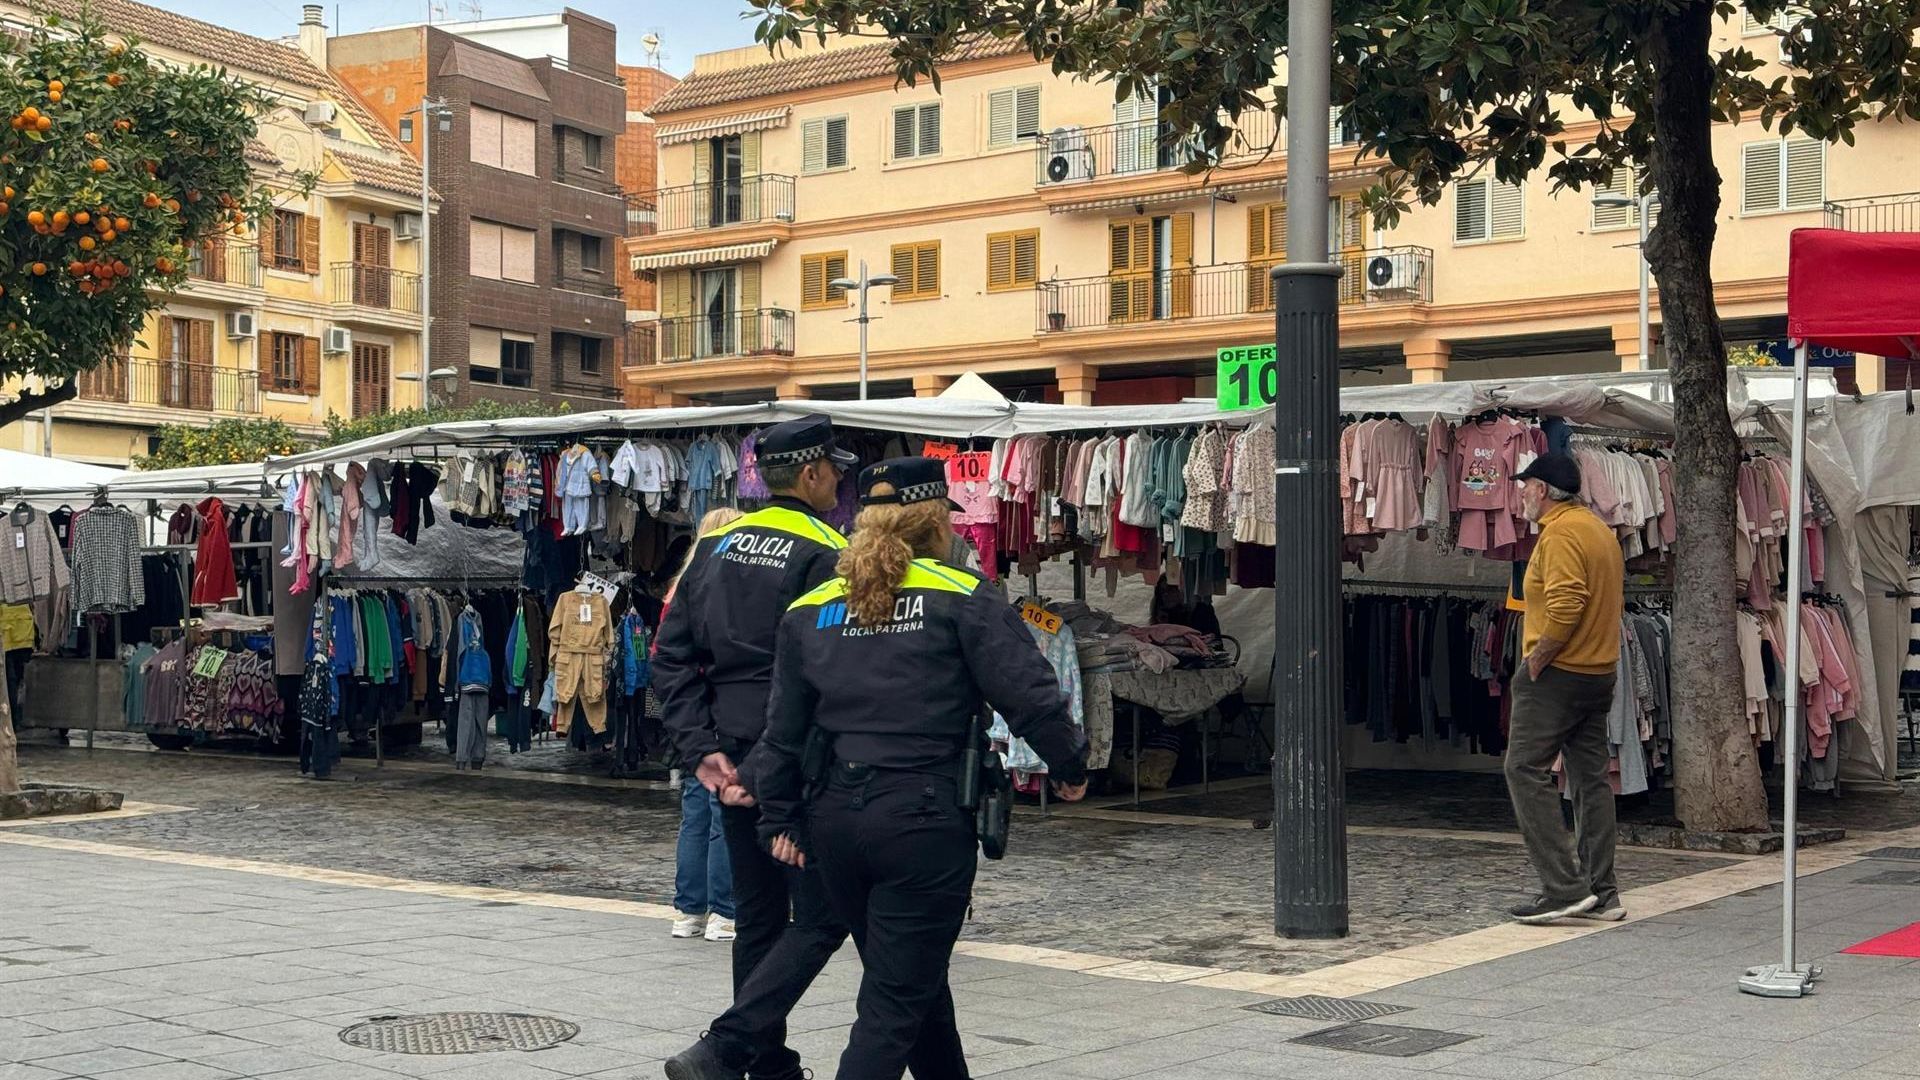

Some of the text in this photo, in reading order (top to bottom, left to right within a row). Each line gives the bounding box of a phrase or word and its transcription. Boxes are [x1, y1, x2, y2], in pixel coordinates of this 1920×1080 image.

[1229, 361, 1277, 406] 10
[729, 533, 794, 558] POLICIA
[721, 552, 786, 569] LOCAL PATERNA
[845, 596, 924, 625] PCIA
[1027, 609, 1042, 624] 10
[842, 620, 924, 637] LOCAL PATERNA
